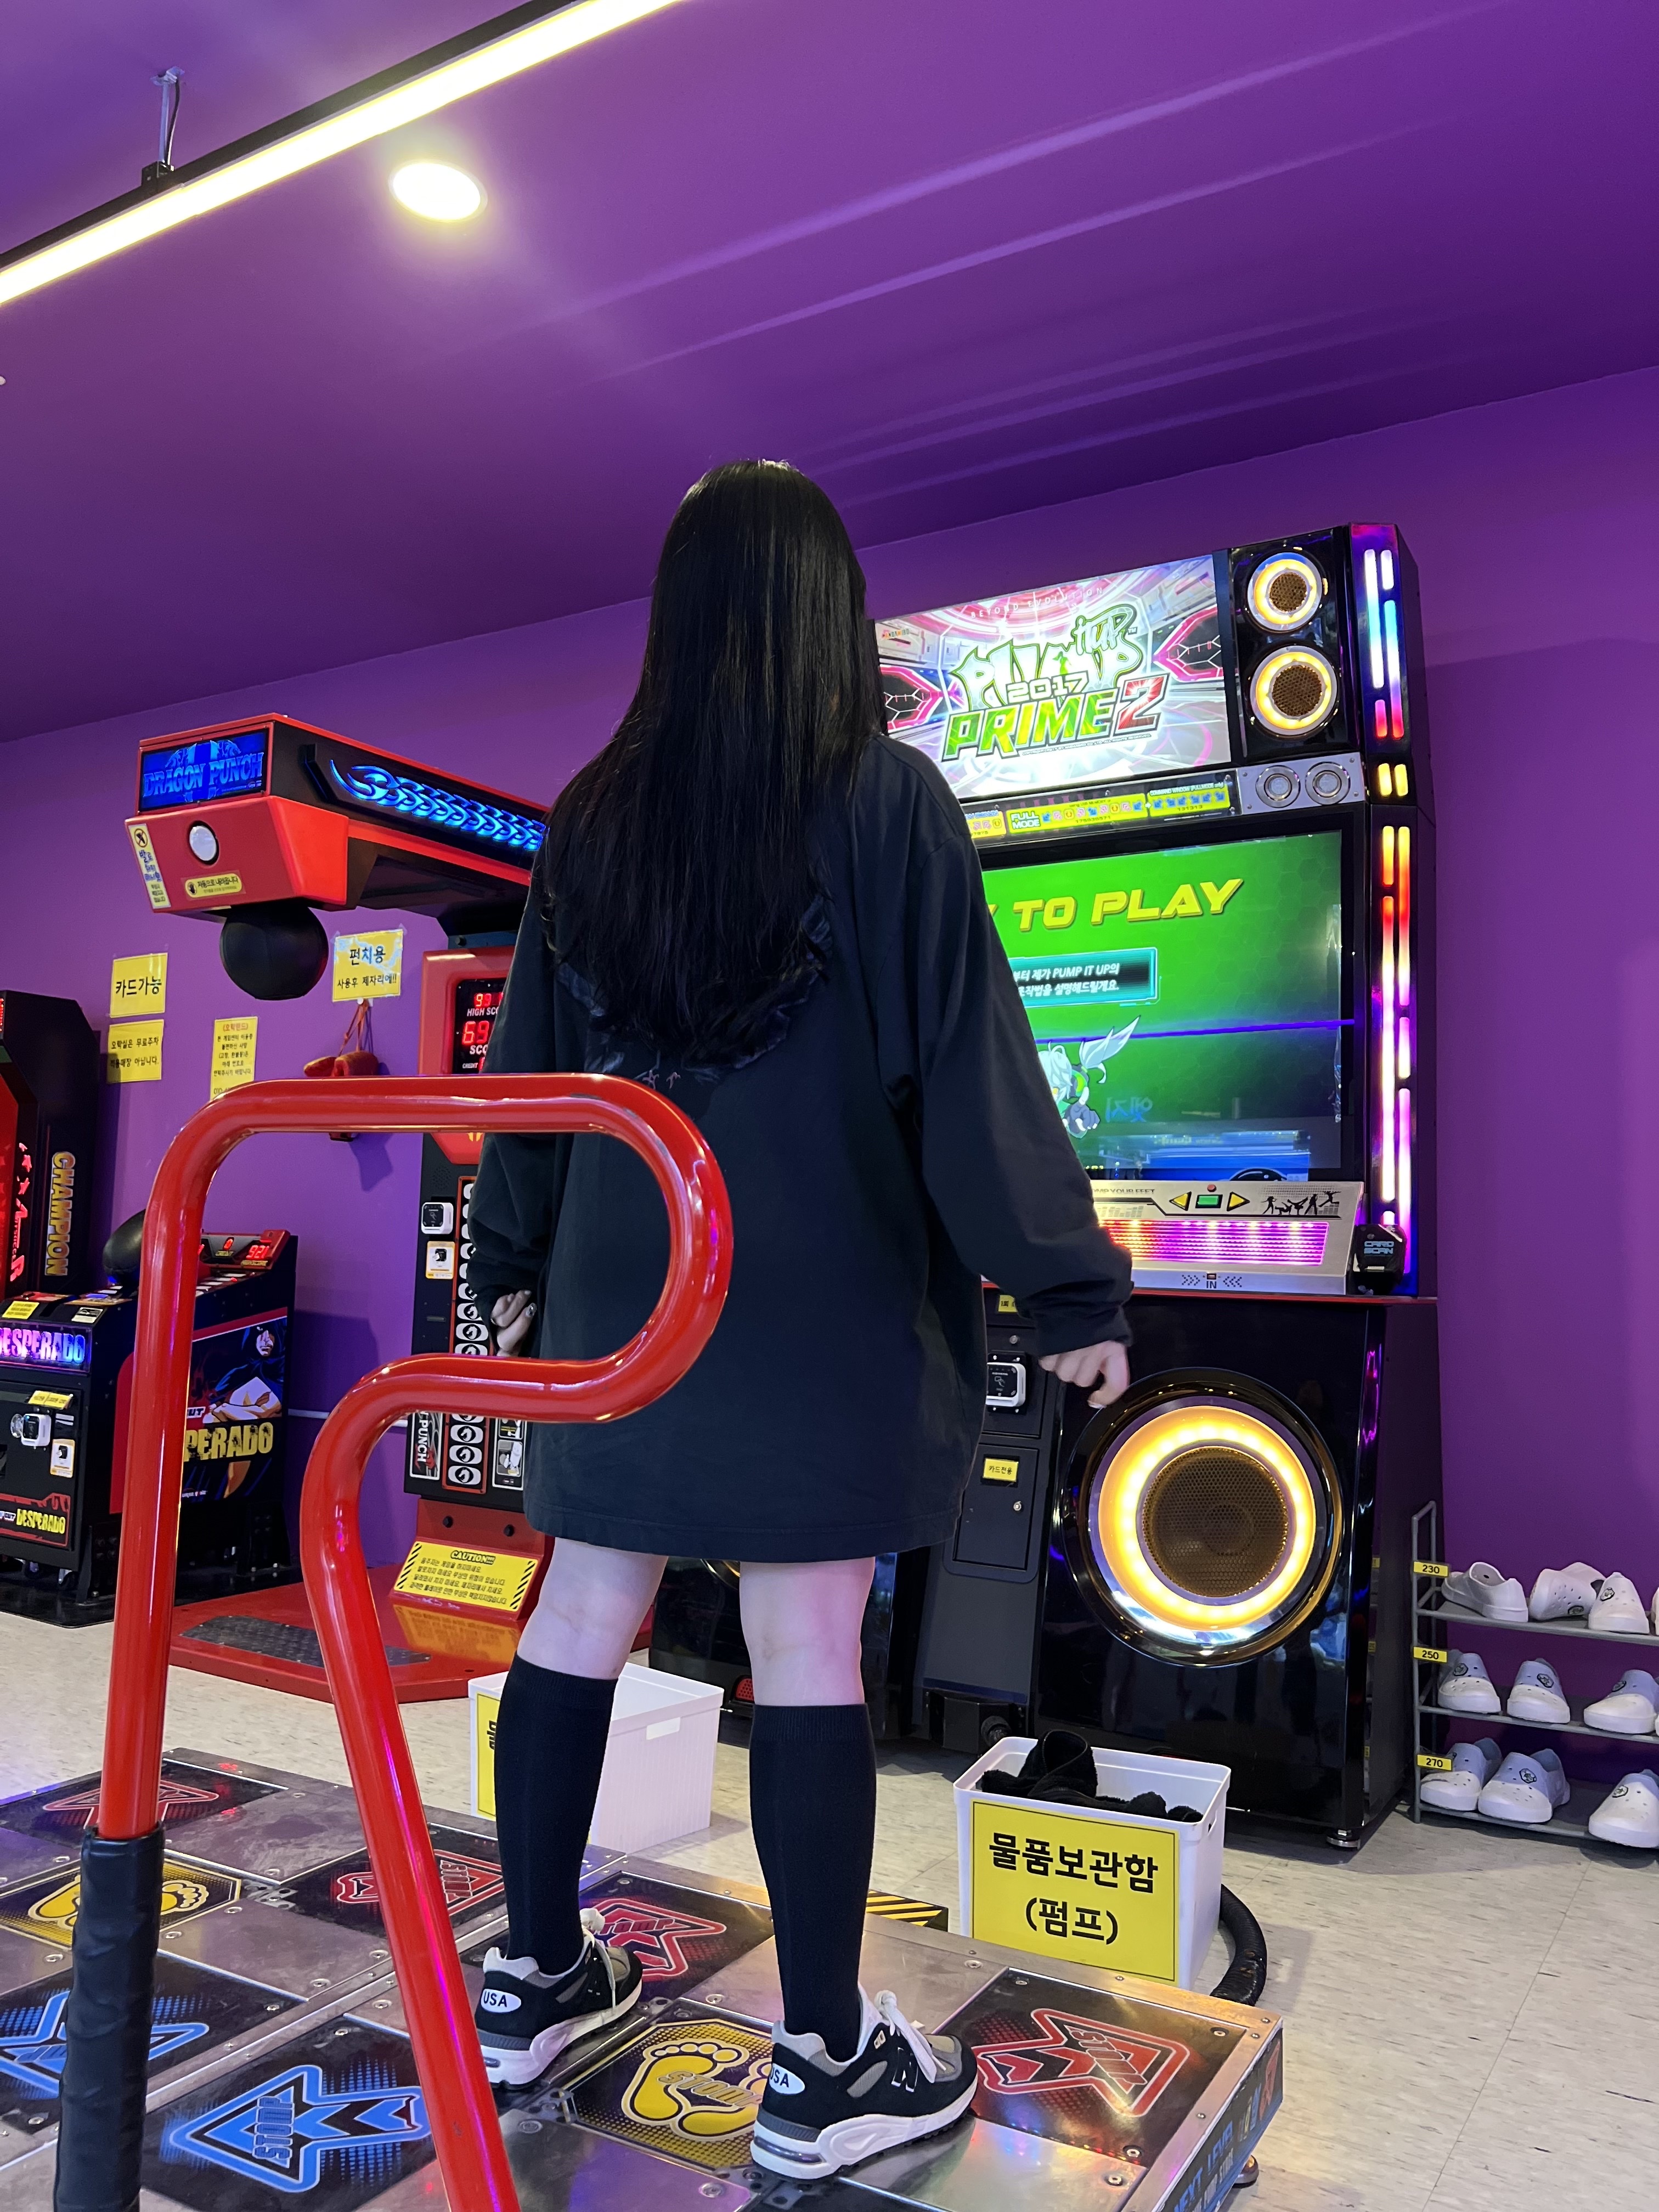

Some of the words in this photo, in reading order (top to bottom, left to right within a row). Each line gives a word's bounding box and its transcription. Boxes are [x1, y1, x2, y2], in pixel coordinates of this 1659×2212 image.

[971, 603, 1019, 618] BEYOND
[1028, 587, 1103, 608] EVOLUTION
[1006, 670, 1090, 704] 2017
[941, 687, 1119, 762] PRIME
[1113, 673, 1170, 737] 2
[143, 763, 206, 798] DRAGON
[208, 752, 264, 786] PUNCH
[1011, 811, 1039, 821] FULL
[1012, 818, 1041, 830] MODE
[1013, 896, 1077, 933] TO
[1090, 878, 1244, 926] PLAY
[350, 946, 386, 966] 펀치용
[1031, 968, 1052, 980] 제가
[1052, 966, 1083, 978] PUMP
[1084, 965, 1094, 976] IT
[1095, 962, 1120, 975] UP의
[116, 977, 162, 998] 카드가능
[337, 977, 358, 989] 사용후
[362, 973, 397, 986] 제자리에!!
[1054, 979, 1120, 996] 설명해드릴게요.
[467, 1007, 485, 1017] HIGH
[136, 1036, 159, 1047] 무료주차
[45, 1151, 76, 1276] CHAMPION
[1206, 1280, 1217, 1289] IN
[417, 1420, 428, 1463] PUNCH
[989, 1465, 1013, 1475] 카드전용
[16, 1508, 66, 1534] DESPERADO
[1422, 1564, 1440, 1575] 230
[1421, 1650, 1439, 1661] 250
[1425, 1757, 1444, 1769] 270
[989, 1832, 1158, 1894] 물품보관함
[1025, 1897, 1119, 1945] (펌프)
[483, 1990, 507, 2008] USA
[252, 2096, 295, 2160] STOMP
